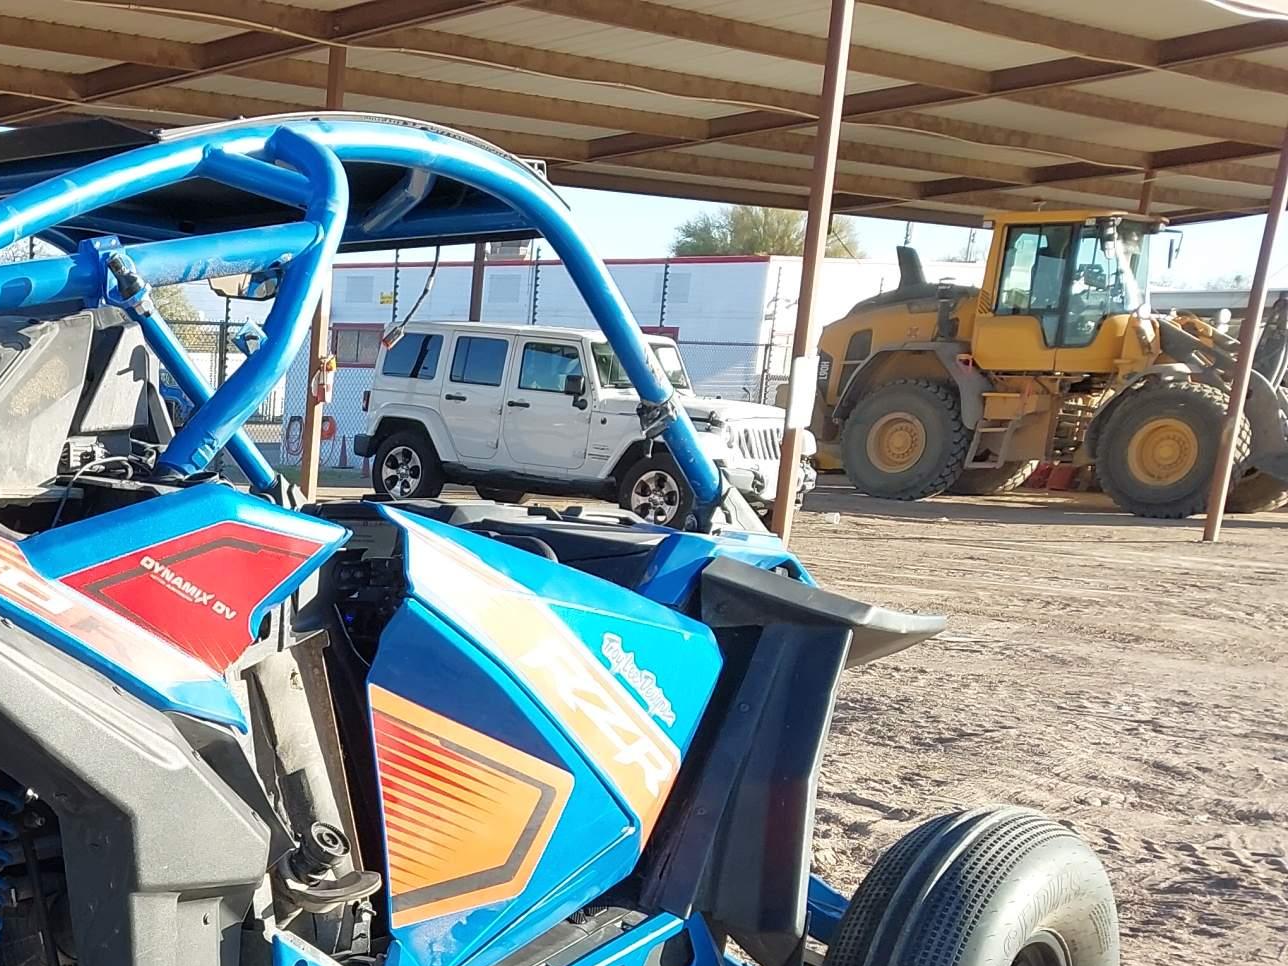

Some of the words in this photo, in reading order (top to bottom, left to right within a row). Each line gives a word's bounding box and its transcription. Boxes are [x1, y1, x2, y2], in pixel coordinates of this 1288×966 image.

[140, 556, 215, 606] DYNAMIX
[212, 600, 237, 620] DV
[517, 637, 674, 799] RZR
